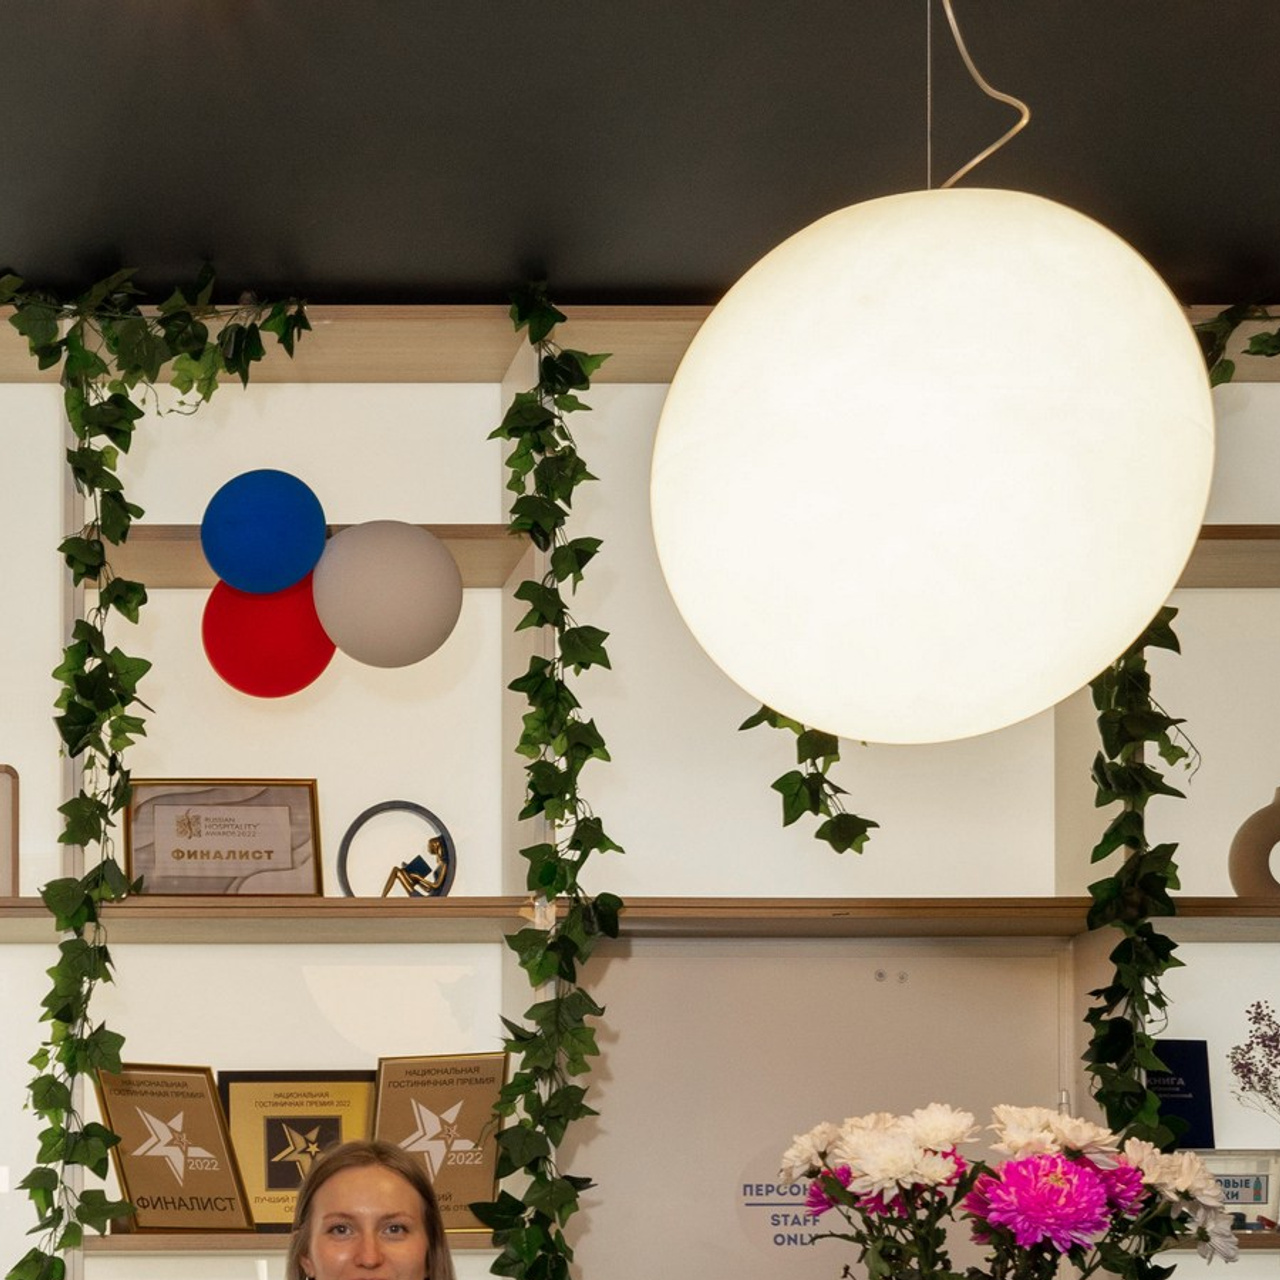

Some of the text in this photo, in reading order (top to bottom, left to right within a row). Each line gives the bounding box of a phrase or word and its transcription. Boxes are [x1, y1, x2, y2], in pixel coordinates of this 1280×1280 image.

[171, 848, 275, 861] ФИНАЛИСТ
[405, 1066, 480, 1077] НАЦИОНАЛЬНАЯ
[388, 1076, 496, 1089] ГОСТИНИЧНАЯ ПРЕМИЯ
[187, 1159, 220, 1171] 2022
[447, 1152, 483, 1166] 2022
[136, 1196, 236, 1212] ФИНАЛИСТ
[770, 1213, 821, 1227] STAFF
[773, 1233, 820, 1246] ONLY
